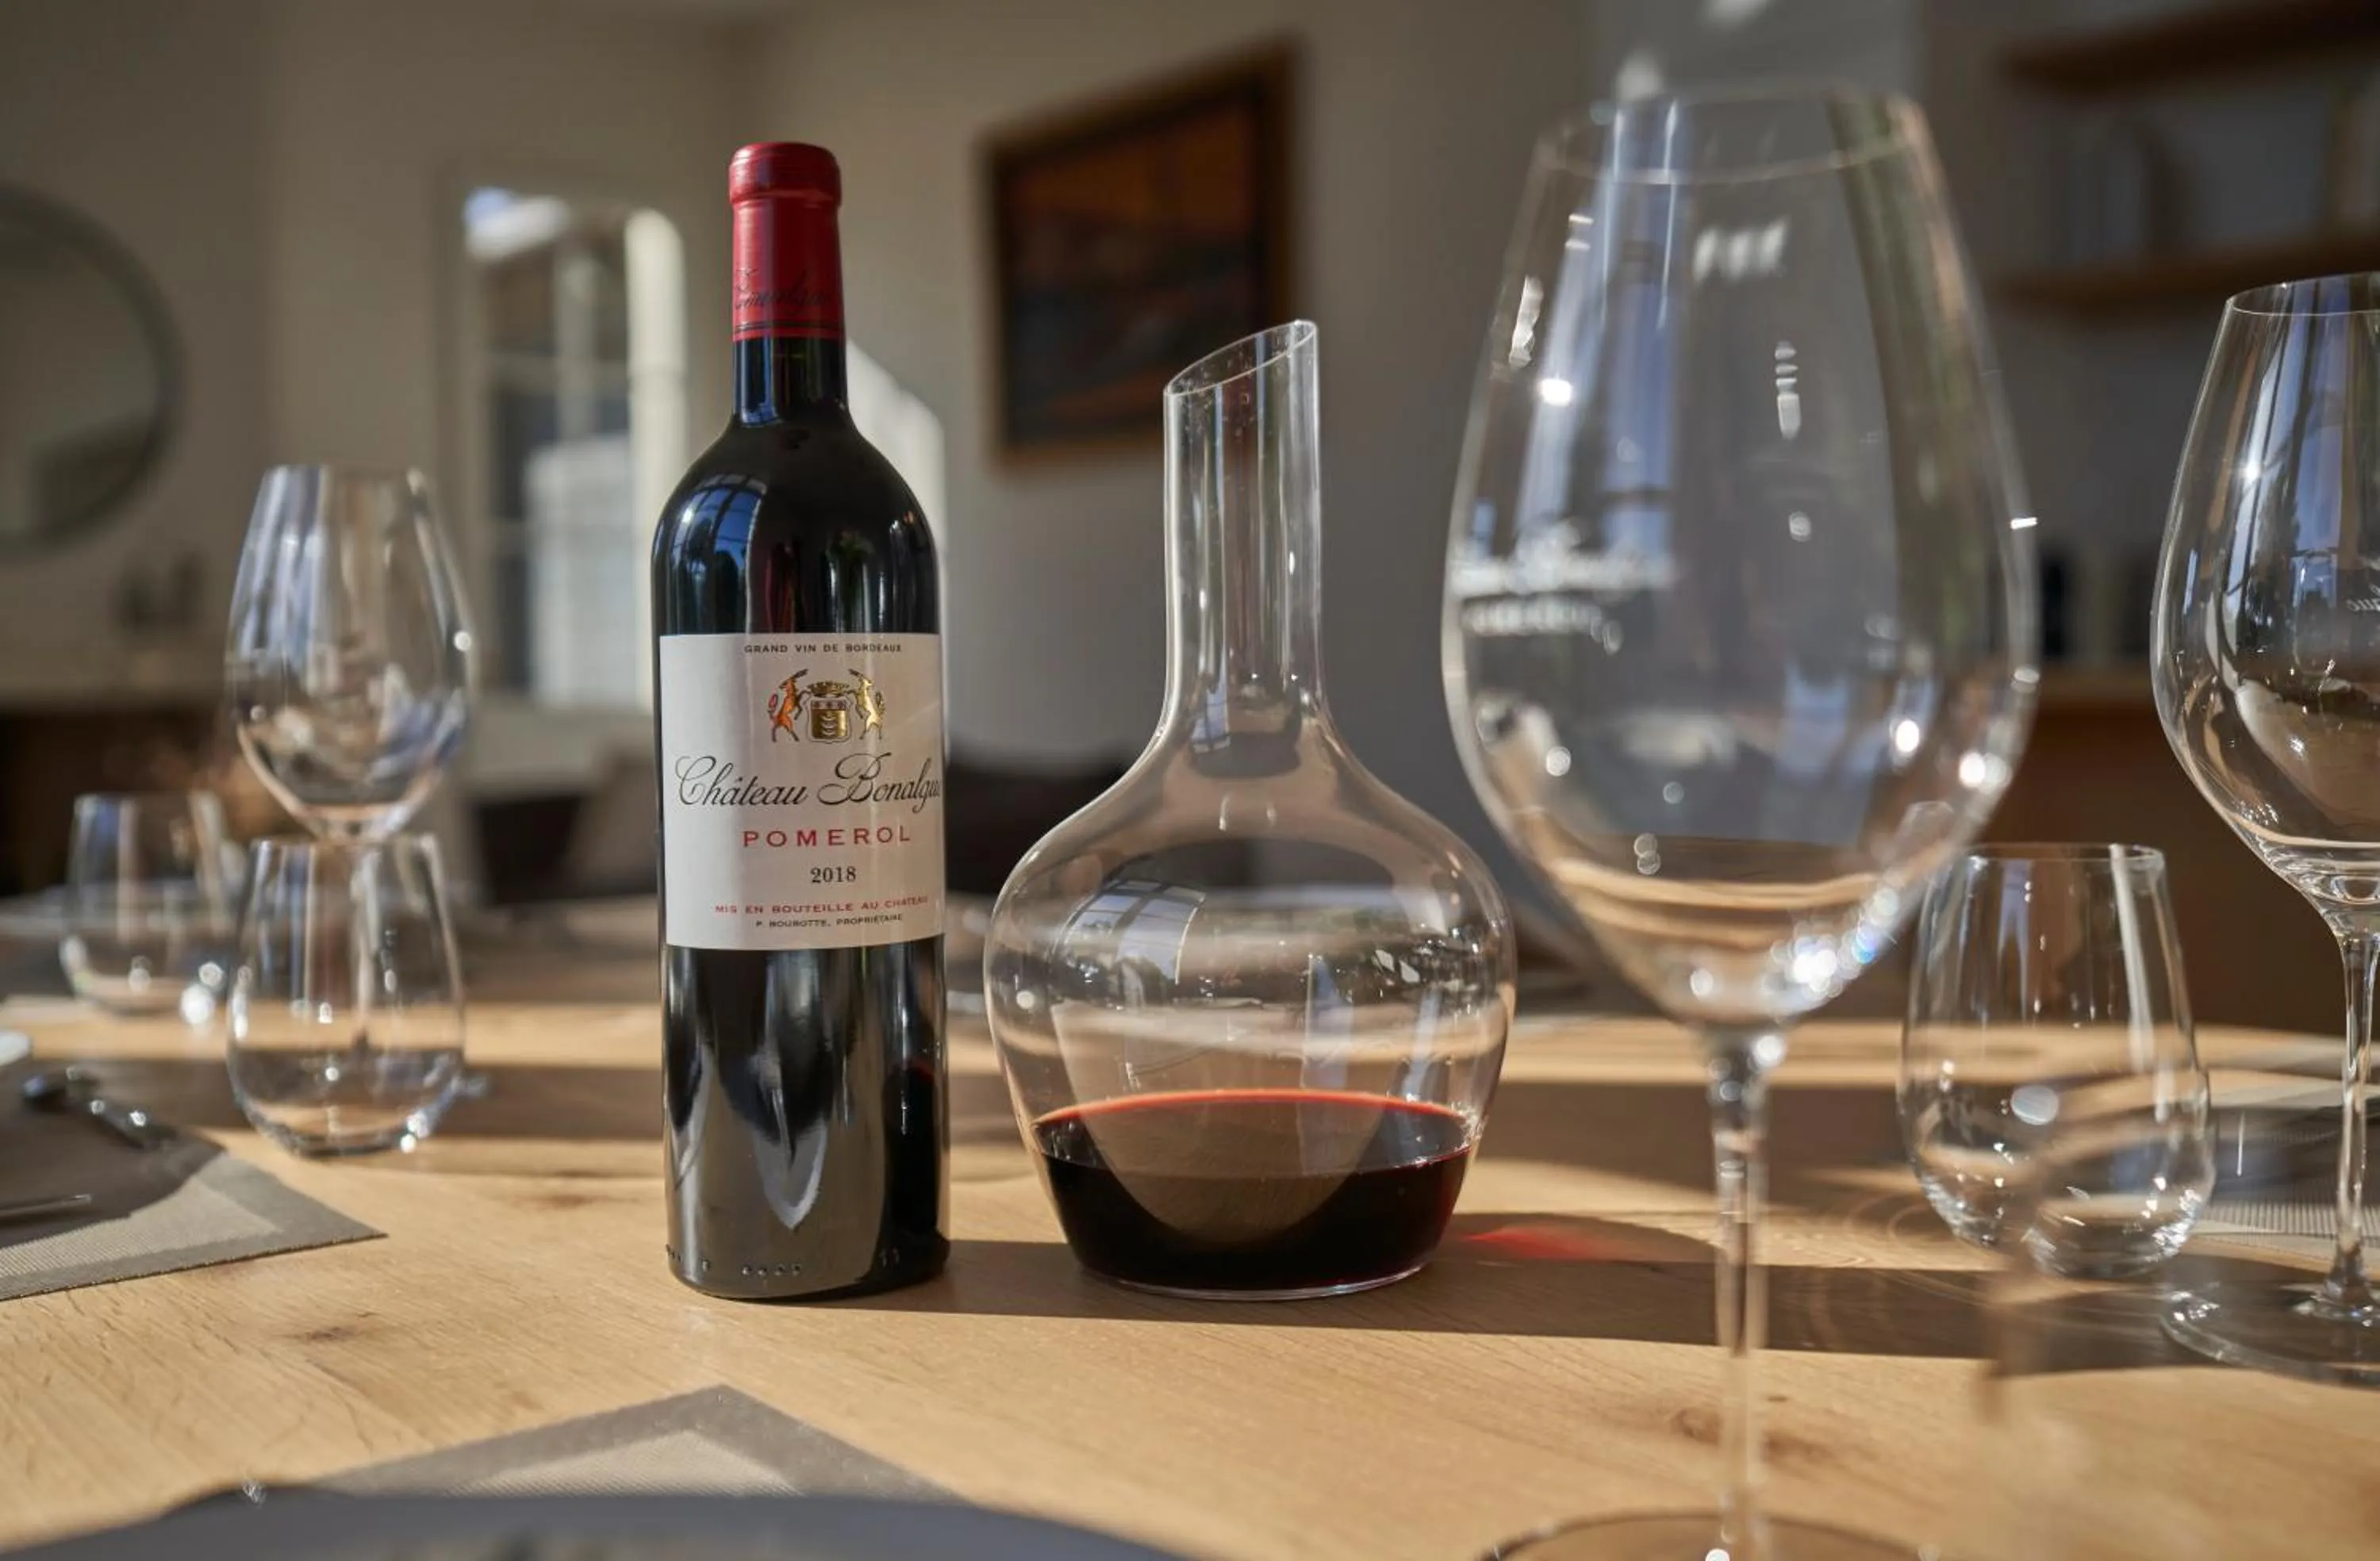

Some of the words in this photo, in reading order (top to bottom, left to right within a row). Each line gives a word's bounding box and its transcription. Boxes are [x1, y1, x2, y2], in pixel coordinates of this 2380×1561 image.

[743, 644, 788, 653] GRAND
[795, 644, 816, 653] VIN
[823, 643, 839, 653] DE
[845, 643, 901, 653] BORDEAUX
[674, 755, 808, 806] Château
[743, 825, 912, 847] POMEROL
[811, 866, 857, 884] 2018
[715, 904, 737, 913] MIS
[745, 904, 763, 914] EN
[772, 903, 852, 913] BOUTEILLE
[861, 901, 878, 910] AU
